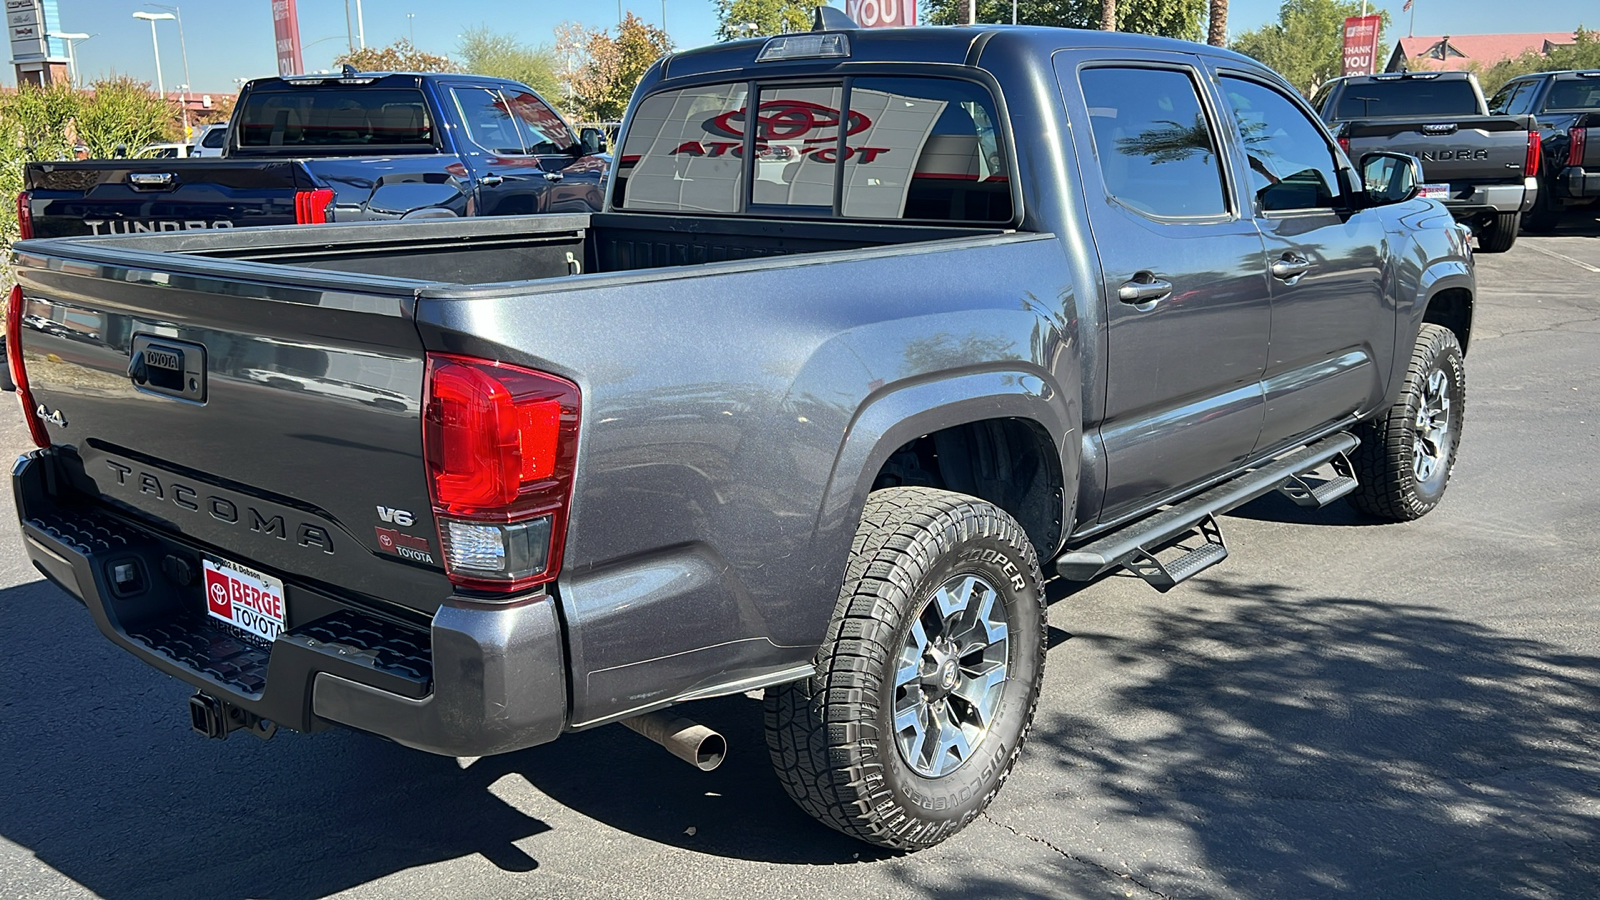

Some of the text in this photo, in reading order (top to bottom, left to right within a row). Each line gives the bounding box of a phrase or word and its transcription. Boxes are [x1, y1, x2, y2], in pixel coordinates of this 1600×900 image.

[848, 0, 897, 26] YOU
[1344, 45, 1371, 54] THANK
[1344, 55, 1369, 68] YOU
[1405, 149, 1488, 162] NDRA
[146, 351, 178, 369] TOYOTA
[106, 459, 334, 555] TACOMA
[376, 505, 417, 527] V6
[396, 546, 434, 564] TOYOTA
[231, 578, 282, 619] BERGE
[233, 606, 284, 638] TOYOTA
